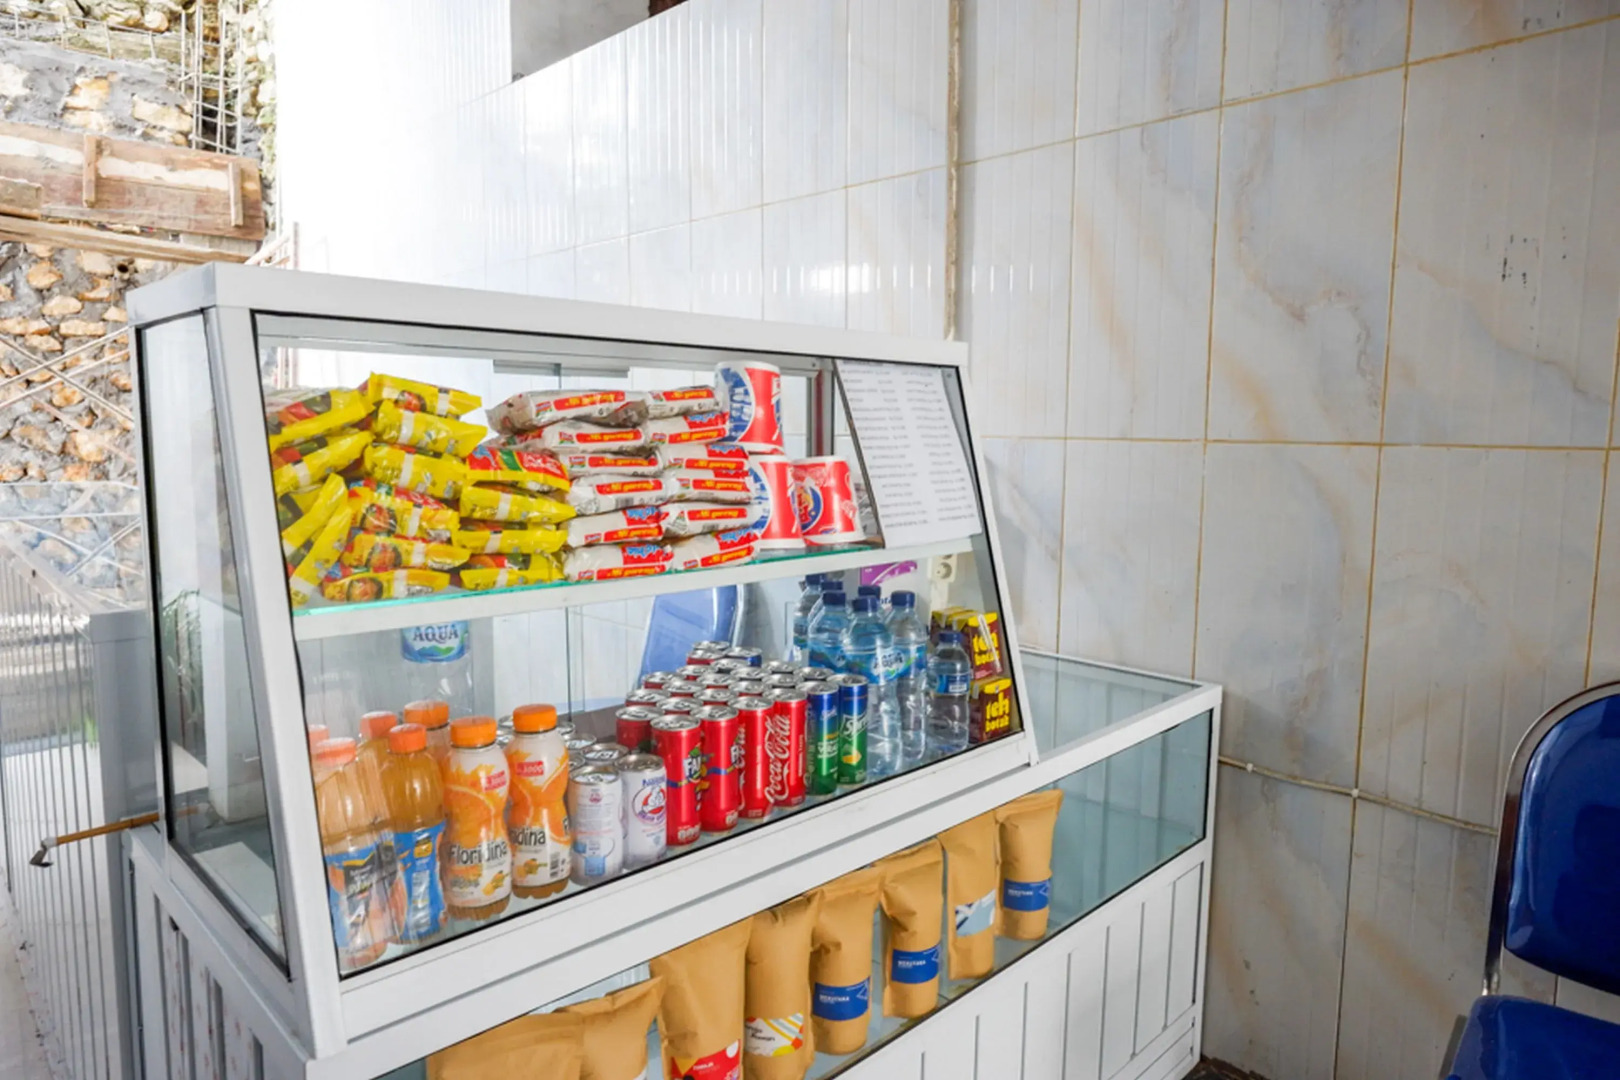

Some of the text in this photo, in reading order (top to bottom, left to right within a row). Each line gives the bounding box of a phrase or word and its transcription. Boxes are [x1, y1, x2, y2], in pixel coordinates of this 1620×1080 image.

[413, 624, 459, 644] AQUA
[986, 696, 1011, 718] teh
[764, 714, 791, 803] Coca-Cola
[448, 841, 508, 865] Floridina
